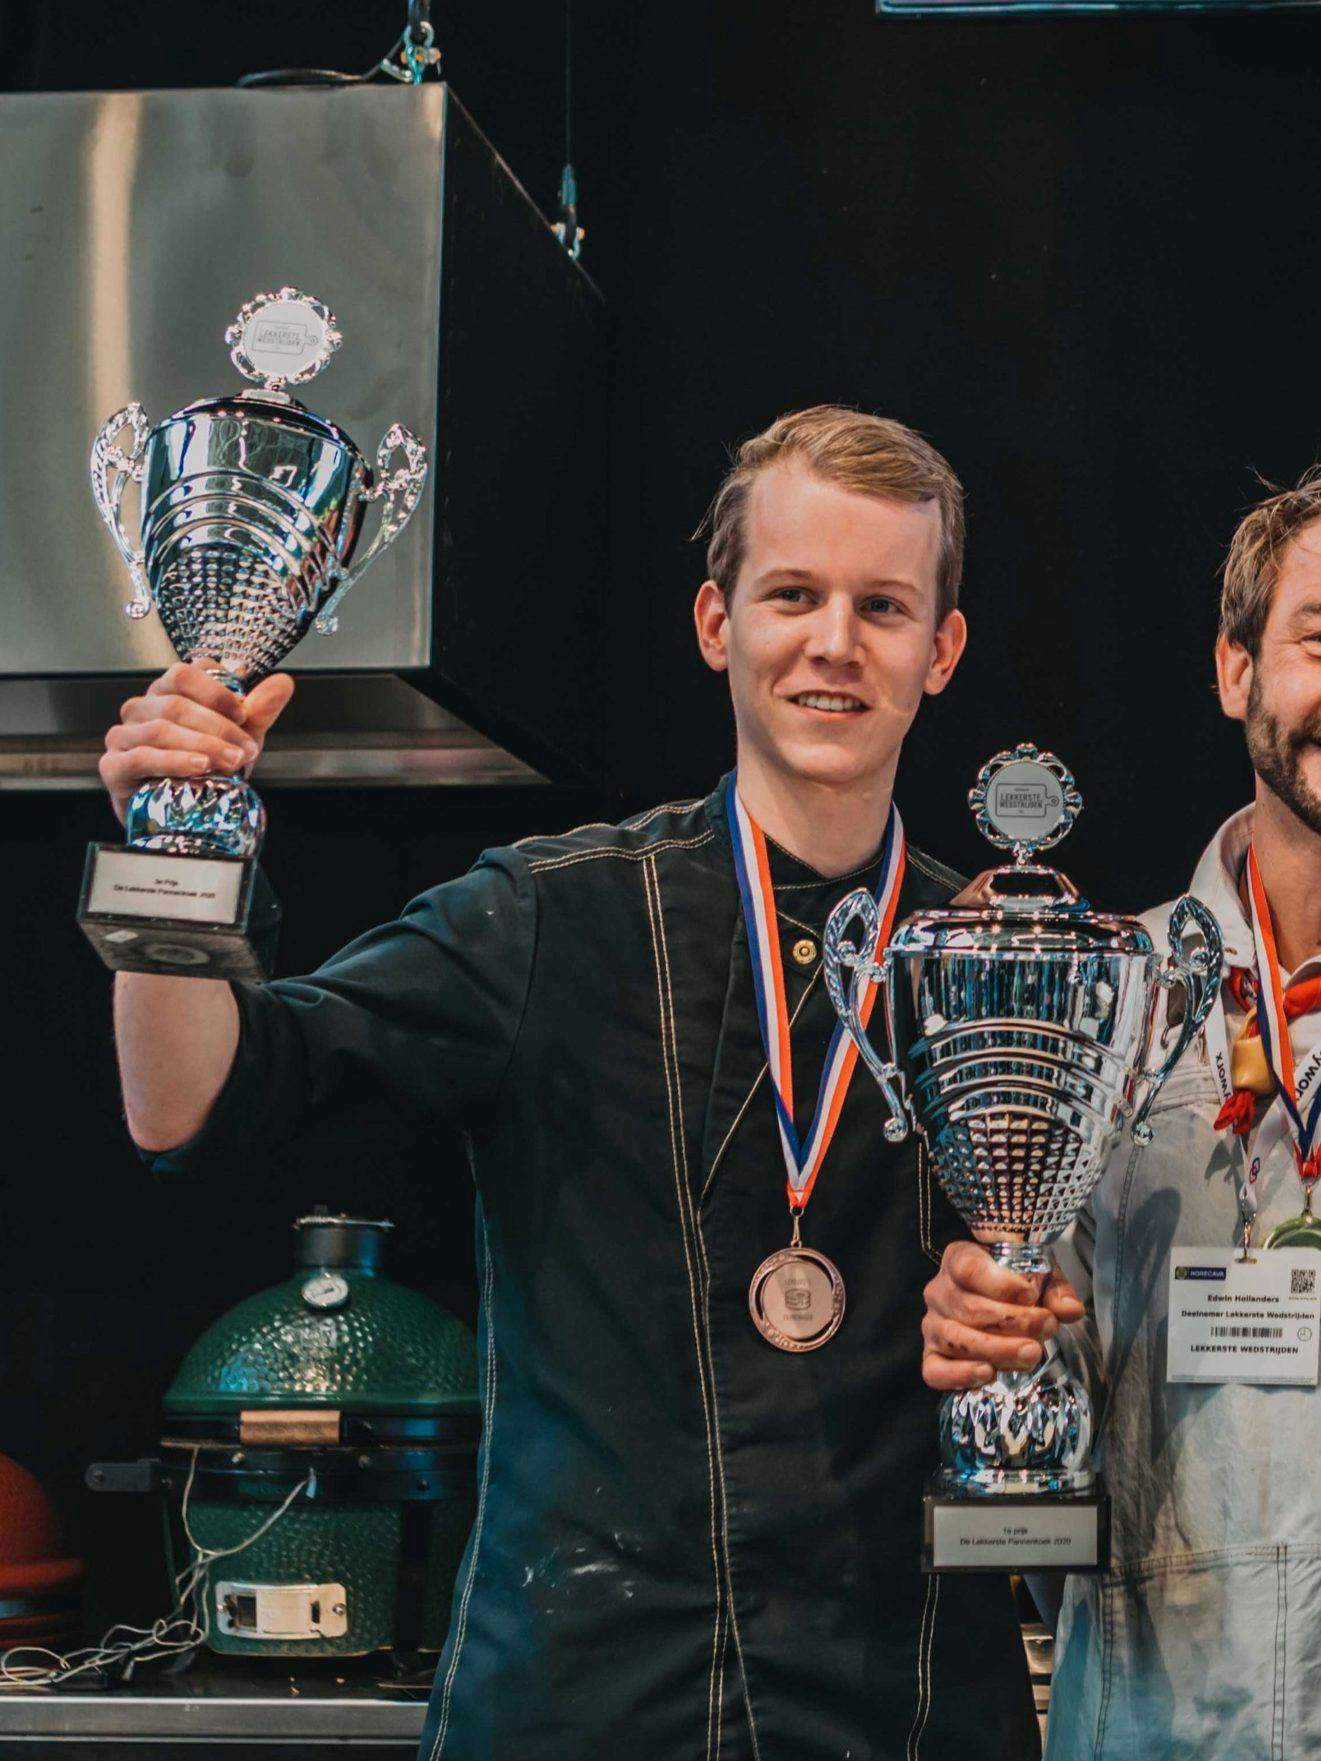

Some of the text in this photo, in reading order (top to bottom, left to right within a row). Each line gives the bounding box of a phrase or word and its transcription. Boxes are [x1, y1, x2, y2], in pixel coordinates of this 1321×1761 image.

[1000, 793, 1041, 801] LEKKERSTE
[1207, 1294, 1232, 1302] Edwin
[1234, 1295, 1279, 1303] Hollanders
[1181, 1310, 1223, 1318] Deelnemer
[1266, 1311, 1315, 1320] Wedstrijden
[1190, 1345, 1299, 1355] LEKKERSTE WEDSTRIJDEN
